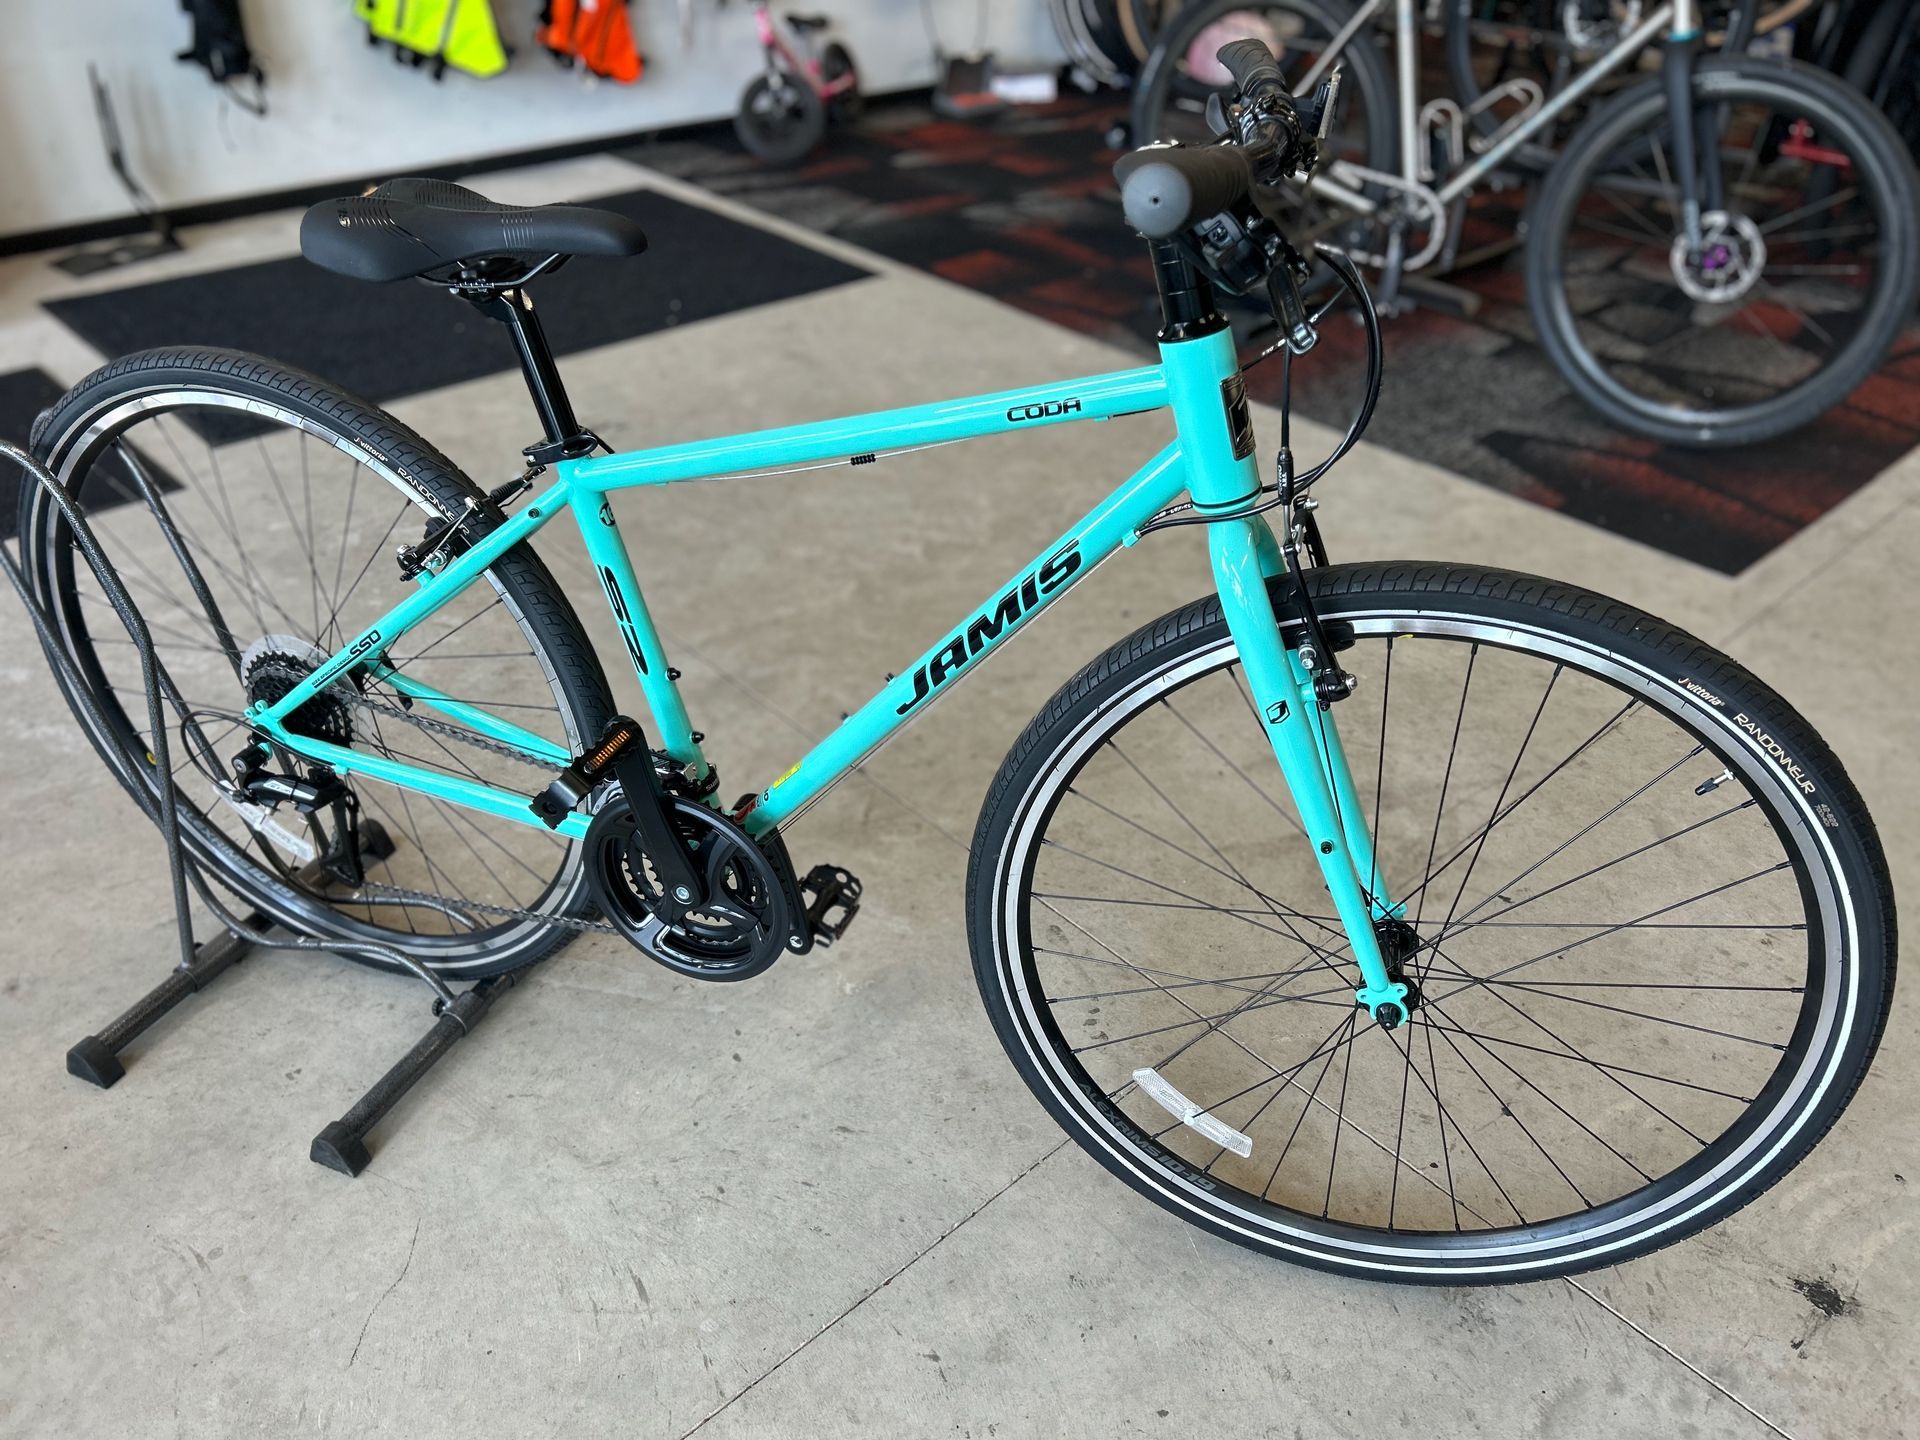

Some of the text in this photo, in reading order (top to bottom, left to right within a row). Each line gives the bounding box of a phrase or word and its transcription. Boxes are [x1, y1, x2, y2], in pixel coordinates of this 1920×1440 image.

[1006, 396, 1082, 422] CODA
[397, 466, 470, 535] RANDONNER
[349, 629, 382, 656] SSD
[895, 537, 1082, 716] JAMIS
[1733, 712, 1816, 795] RANDONNEUR
[1078, 1083, 1163, 1159] ALEXRIMS
